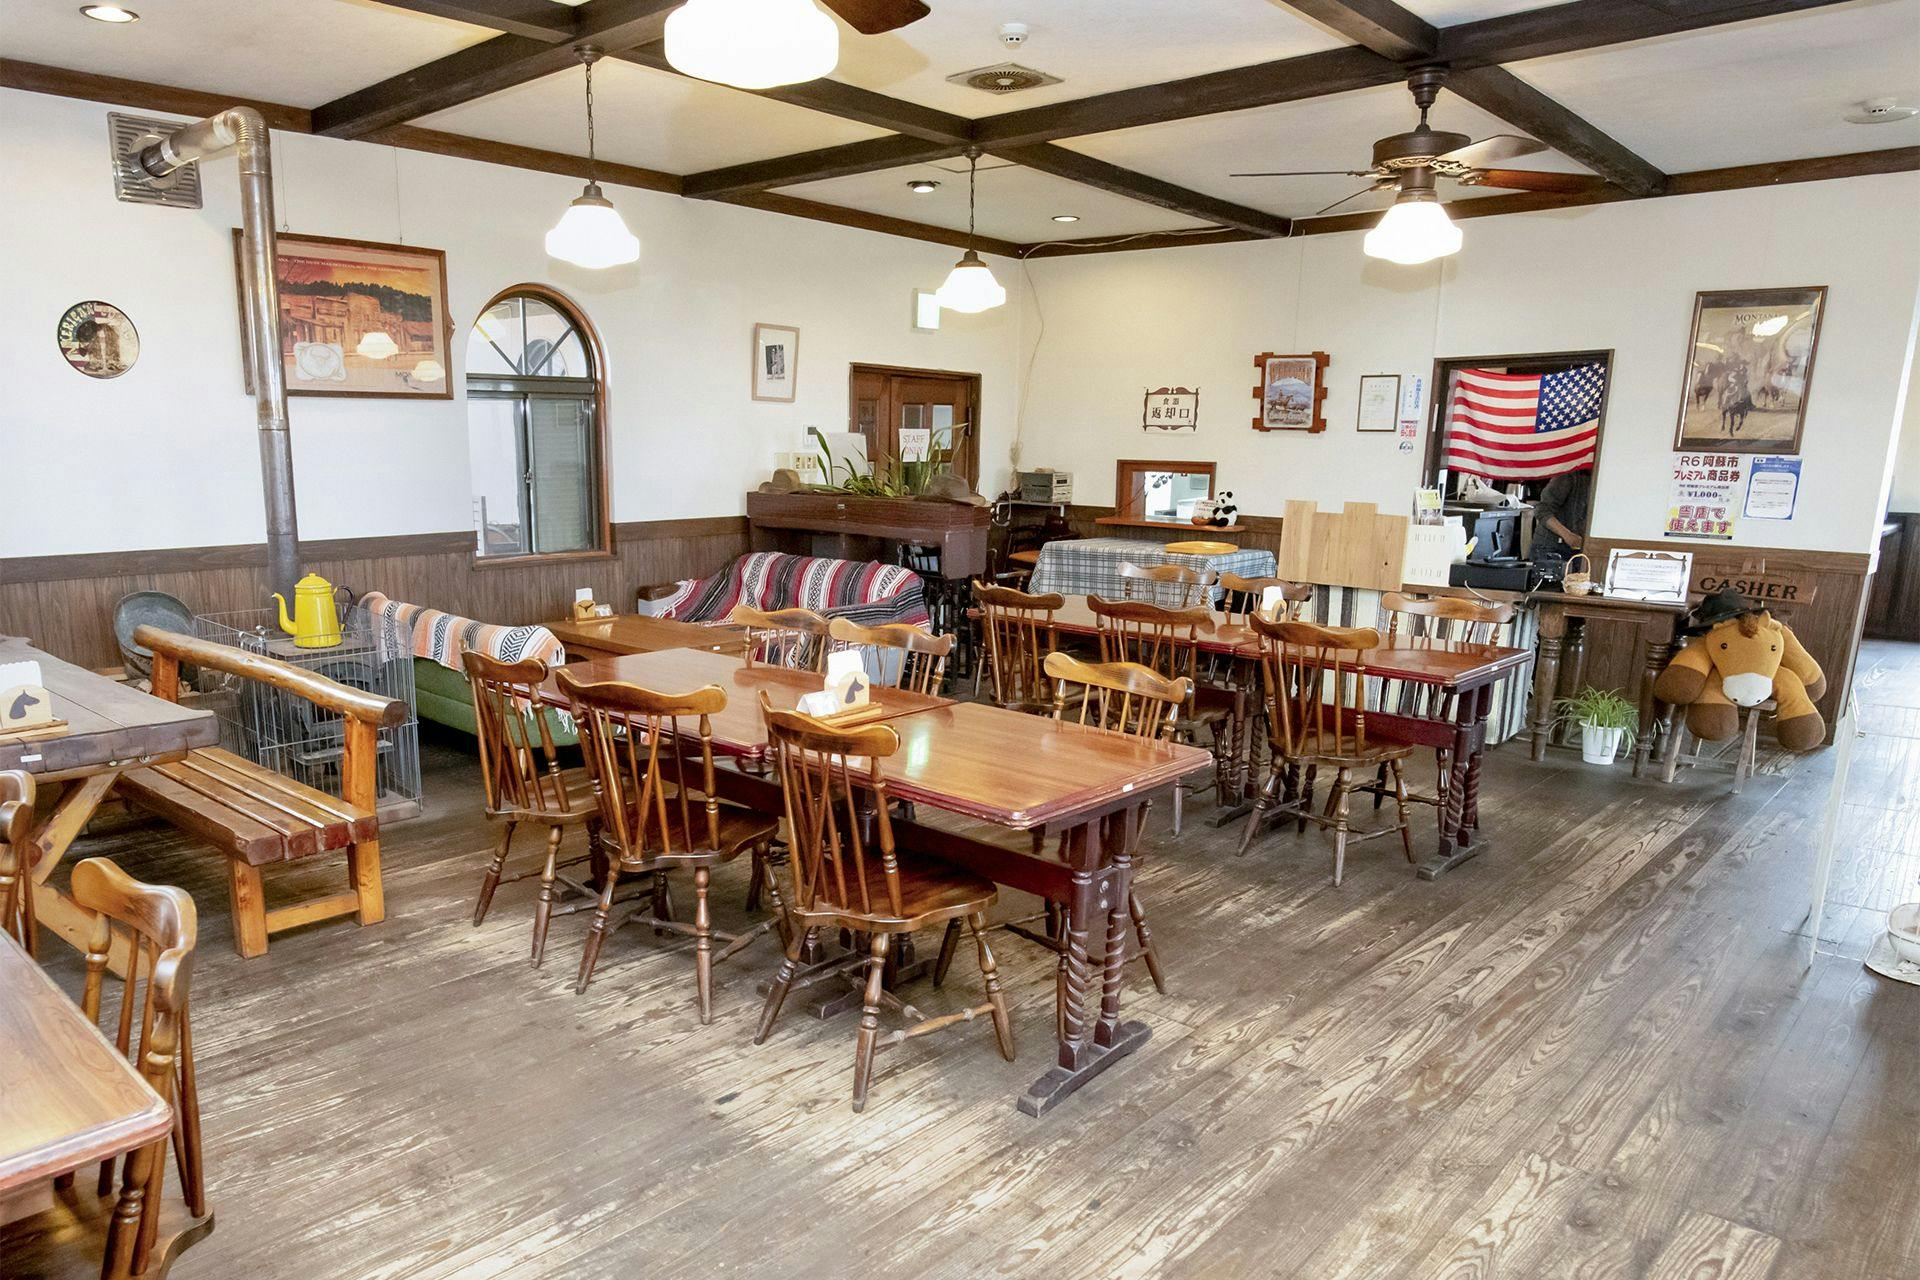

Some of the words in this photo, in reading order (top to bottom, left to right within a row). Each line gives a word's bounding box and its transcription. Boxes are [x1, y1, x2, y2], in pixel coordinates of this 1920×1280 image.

[1152, 407, 1190, 419] 返却口
[1700, 577, 1798, 600] CASHER
